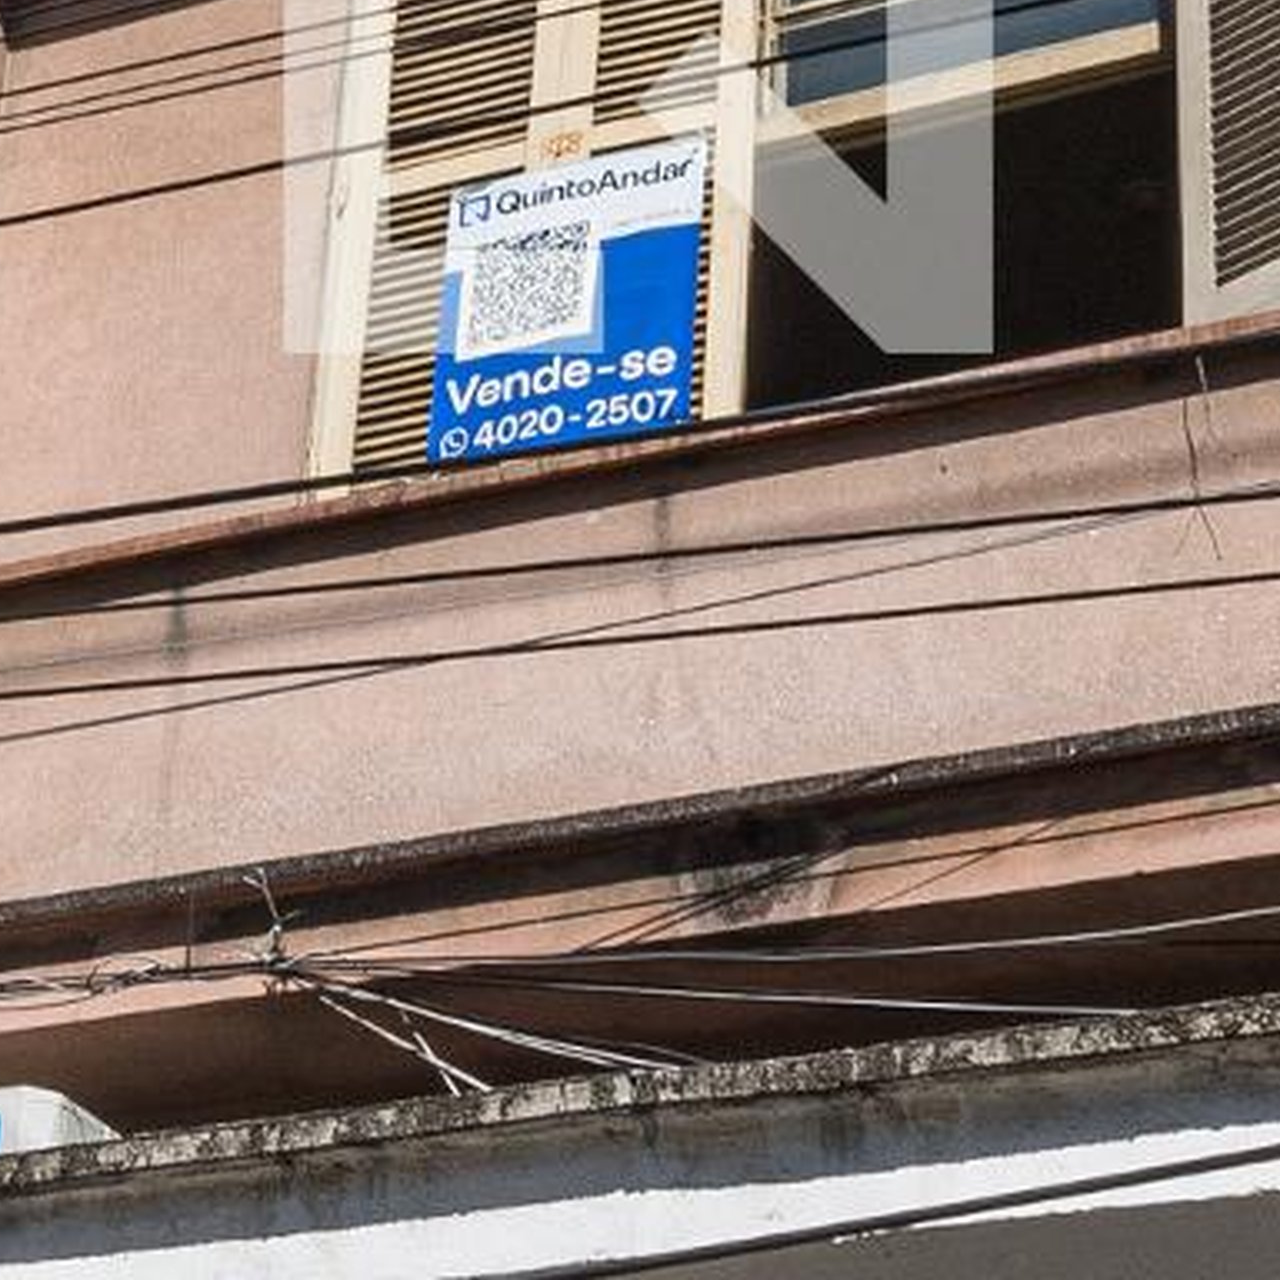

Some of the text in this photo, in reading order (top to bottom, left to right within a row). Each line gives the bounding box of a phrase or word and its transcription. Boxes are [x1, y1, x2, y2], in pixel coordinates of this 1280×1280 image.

[496, 159, 694, 215] QuintoAndar
[446, 346, 677, 415] Vende-se
[473, 389, 678, 450] 4020-2507
